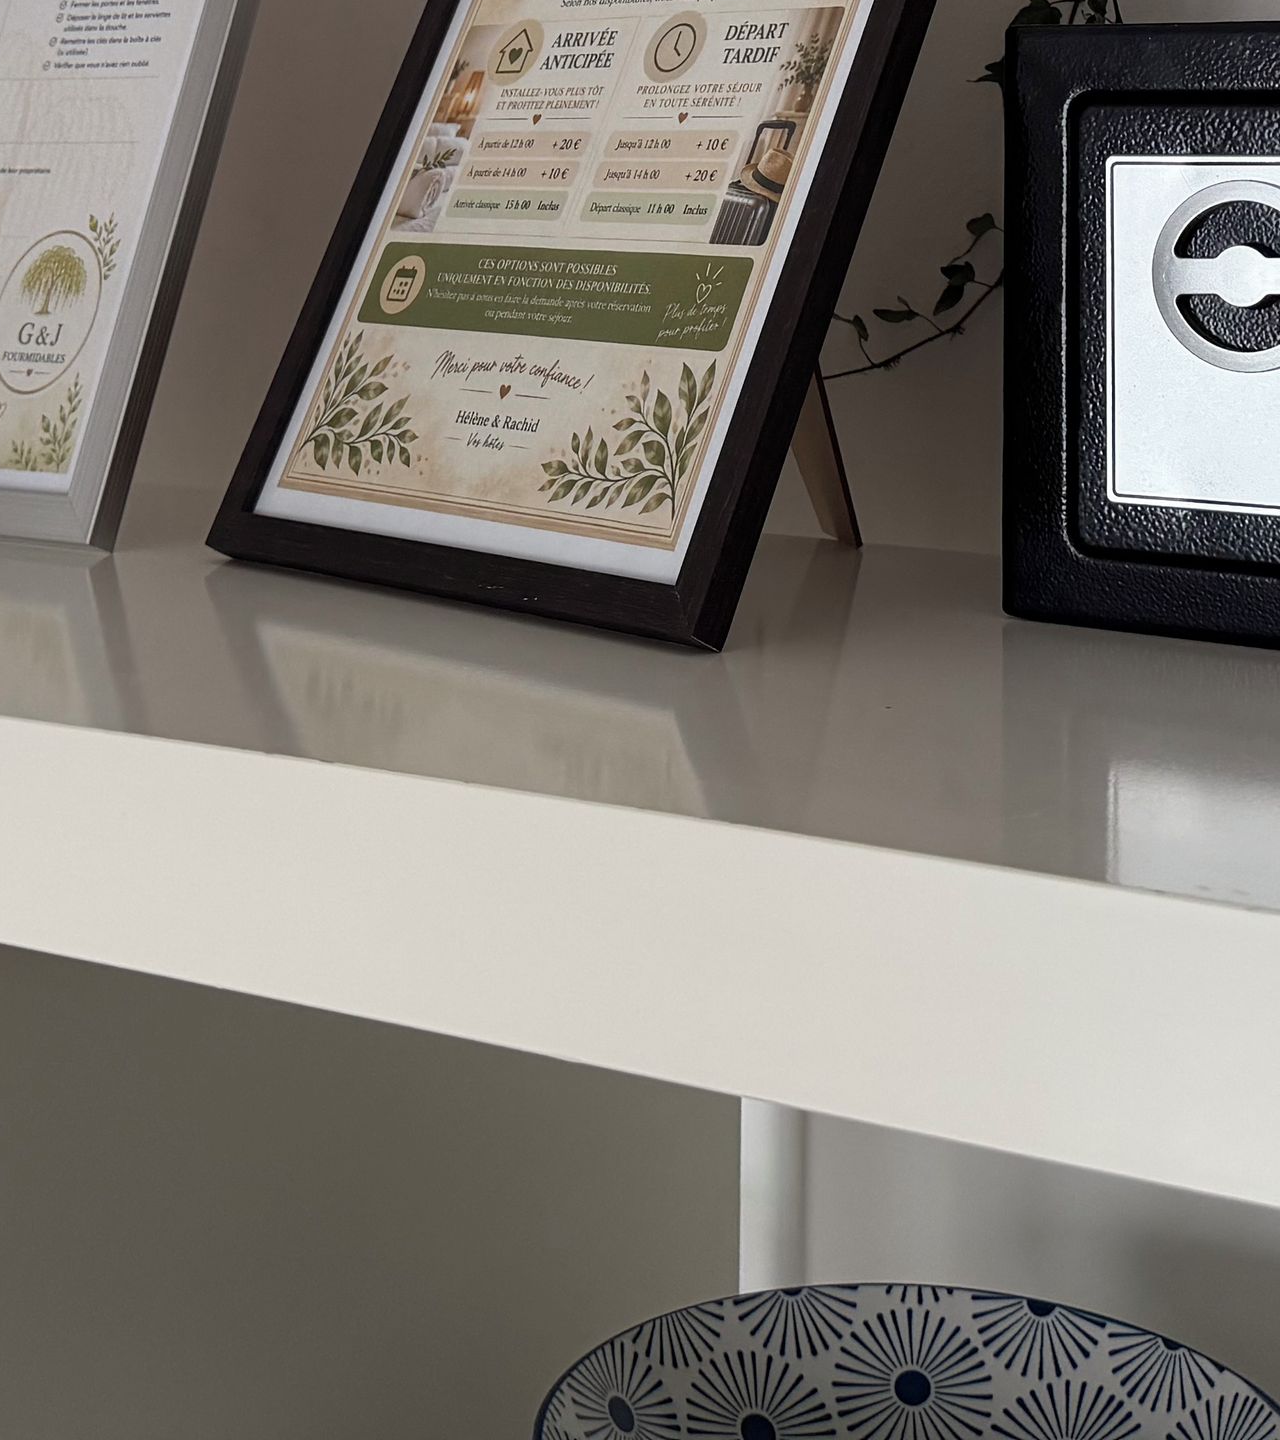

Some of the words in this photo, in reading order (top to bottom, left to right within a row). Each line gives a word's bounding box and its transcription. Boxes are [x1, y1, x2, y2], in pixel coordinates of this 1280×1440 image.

[551, 27, 619, 48] ARRIVÉE
[724, 21, 790, 41] DÉPART
[539, 50, 615, 70] ANTICIPÉE
[722, 46, 781, 64] TARDIF
[500, 87, 565, 98] INSTALLEZ-VOUS
[565, 86, 587, 97] PLUS
[587, 84, 605, 96] TÔT
[636, 84, 691, 95] PROLONGEZ
[694, 83, 725, 94] VOTRE
[726, 82, 763, 93] SÉJOUR
[495, 101, 507, 111] ET
[506, 100, 545, 111] PROFITEZ
[544, 99, 597, 110] PLEINEMENT
[643, 98, 656, 108] EN
[659, 97, 690, 108] TOUTE
[692, 95, 736, 108] SÉRÉNITÉ
[483, 141, 502, 151] partir
[501, 139, 510, 149] de
[614, 139, 643, 151] Jusqu'à
[472, 169, 493, 180] partir
[492, 167, 502, 177] de
[603, 168, 632, 182] Jusqu'à
[589, 202, 613, 215] Départ
[612, 203, 642, 216] classique
[682, 204, 708, 215] Inclus
[478, 258, 495, 269] CES
[496, 259, 538, 271] OPTIONS
[539, 262, 565, 273] SONT
[565, 262, 617, 276] POSSIBLES
[437, 272, 493, 285] UNIQUEMENT
[493, 275, 505, 285] EN
[507, 276, 553, 288] FONCTION
[555, 279, 573, 290] DES
[575, 280, 650, 294] DISPONIBILITÉS.
[1, 350, 66, 364] FOURMIDABLES
[430, 350, 469, 379] Merci
[465, 360, 497, 381] pour
[499, 354, 527, 374] votre
[528, 359, 581, 390] confiance
[579, 374, 595, 394] !
[455, 409, 490, 427] Hélène
[491, 414, 501, 428] &
[502, 415, 541, 433] Rachid
[466, 432, 481, 448] Vos
[482, 433, 505, 451] hôtes
